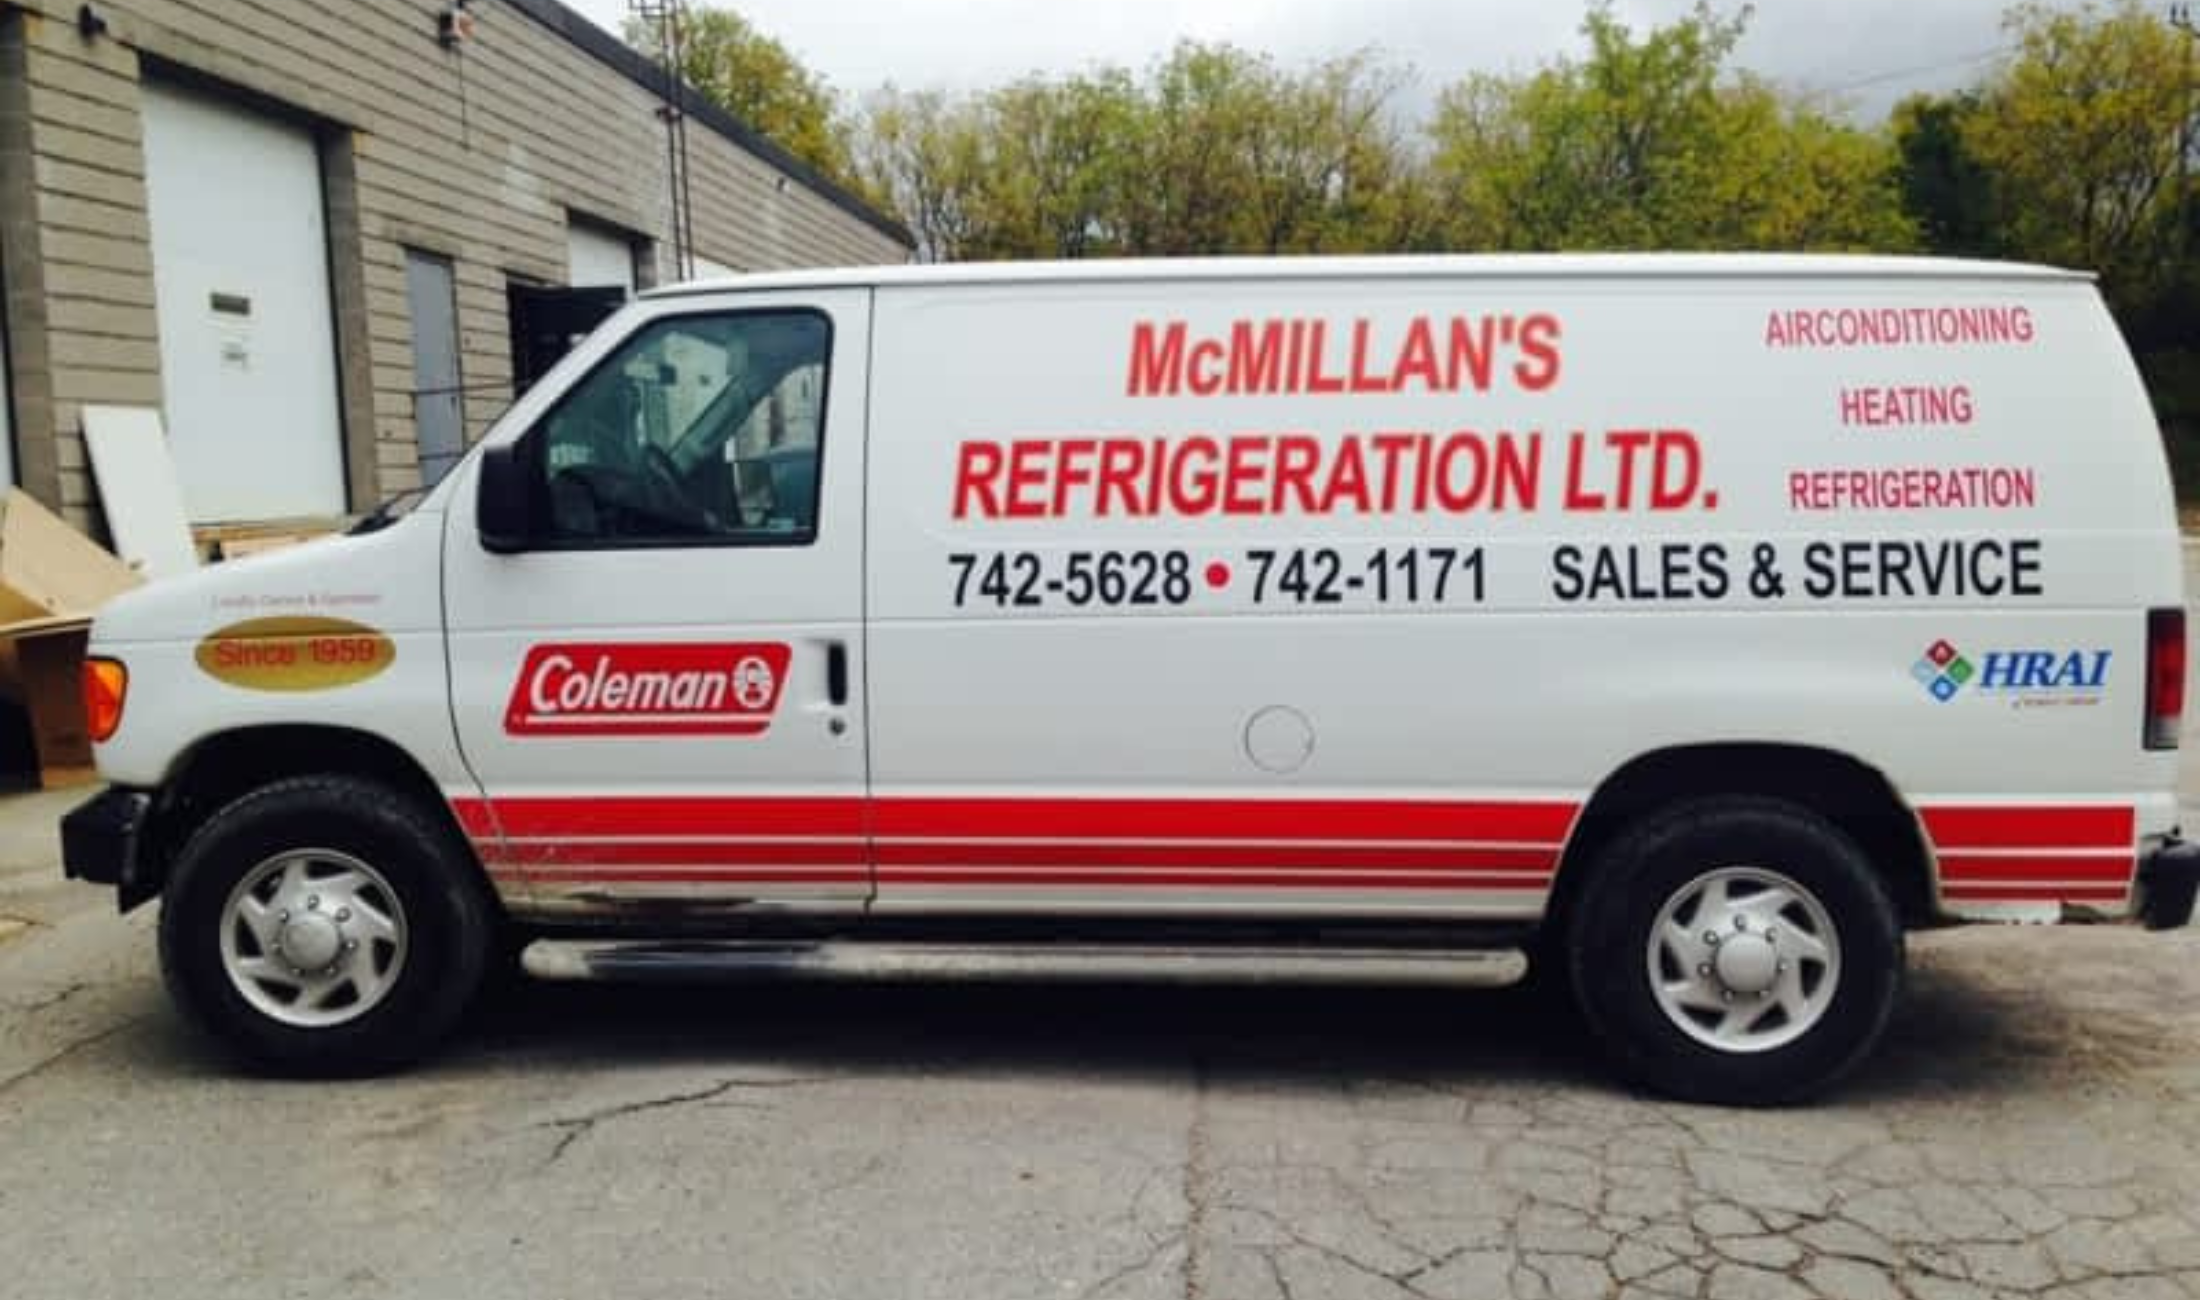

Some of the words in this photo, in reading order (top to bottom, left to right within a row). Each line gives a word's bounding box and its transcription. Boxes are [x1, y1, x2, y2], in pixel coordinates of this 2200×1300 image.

[1766, 307, 2035, 346] AIRCONDITIONING
[1127, 314, 1562, 397] McMILLAN'S
[1839, 385, 1975, 425] HEATING
[952, 429, 1543, 520] REFRIGERATION
[1562, 428, 1719, 514] LTD.
[1788, 466, 2036, 511] REFRIGERATION
[948, 550, 1191, 607] 742-5628
[1246, 547, 1485, 603] 742-1171
[1552, 543, 1729, 601] SALES
[1749, 542, 1786, 599] &
[1803, 539, 2043, 599] SERVICE
[217, 637, 297, 669] Since
[1980, 650, 2112, 688] HRAI
[530, 654, 728, 711] Coleman
